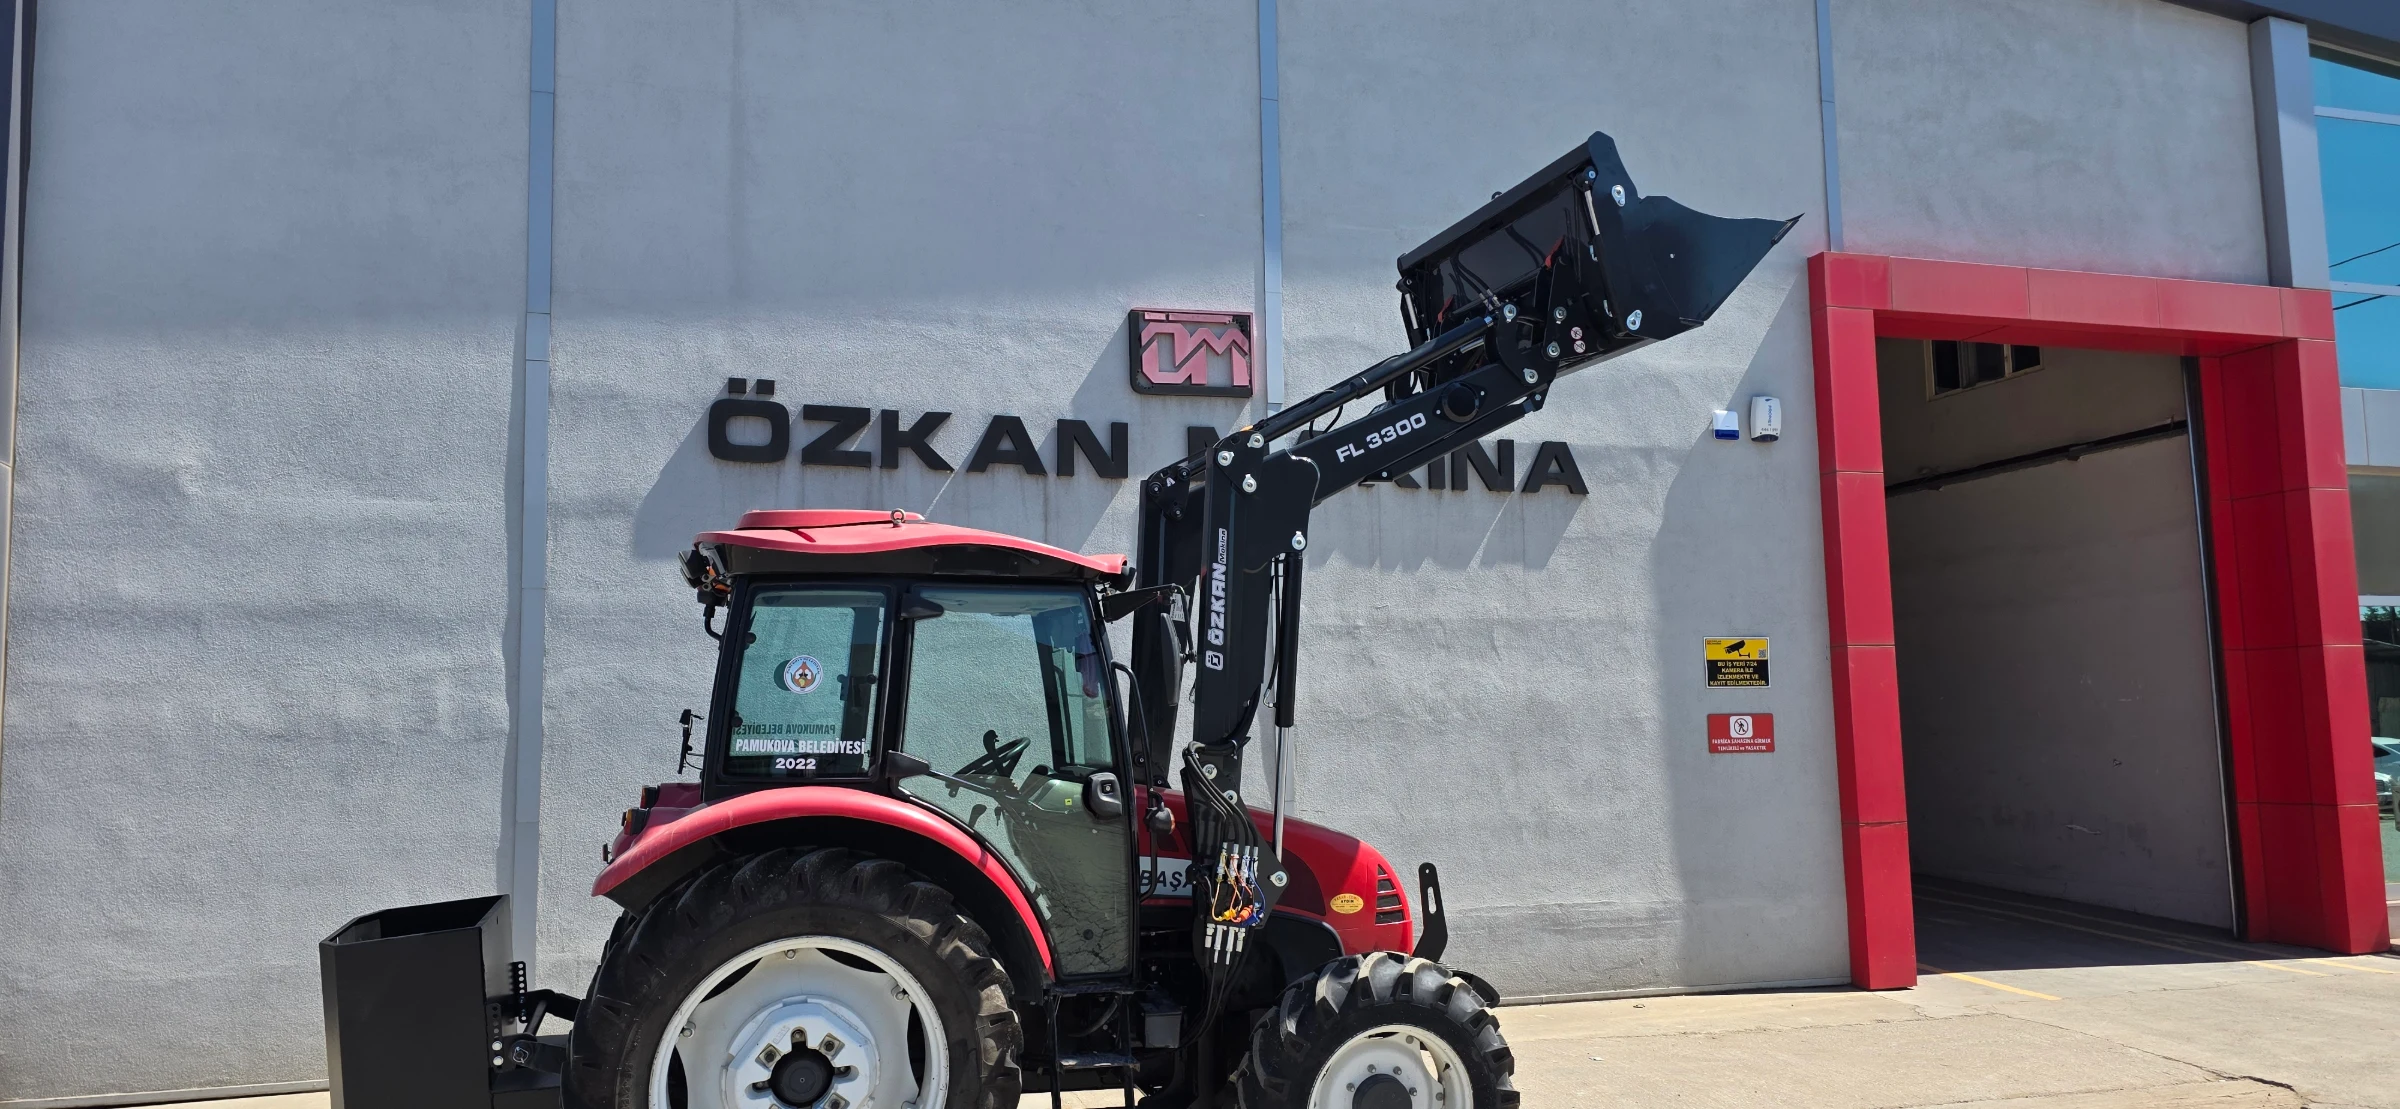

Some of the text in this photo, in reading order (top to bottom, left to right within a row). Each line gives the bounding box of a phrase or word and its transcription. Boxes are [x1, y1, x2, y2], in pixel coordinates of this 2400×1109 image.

[707, 377, 1130, 480] ÖZKAN
[1336, 412, 1427, 464] FL 3300
[1207, 562, 1227, 646] ÖZKAN
[735, 737, 866, 754] PAMUKOVA BELEDİYESİ
[775, 758, 817, 770] 2022
